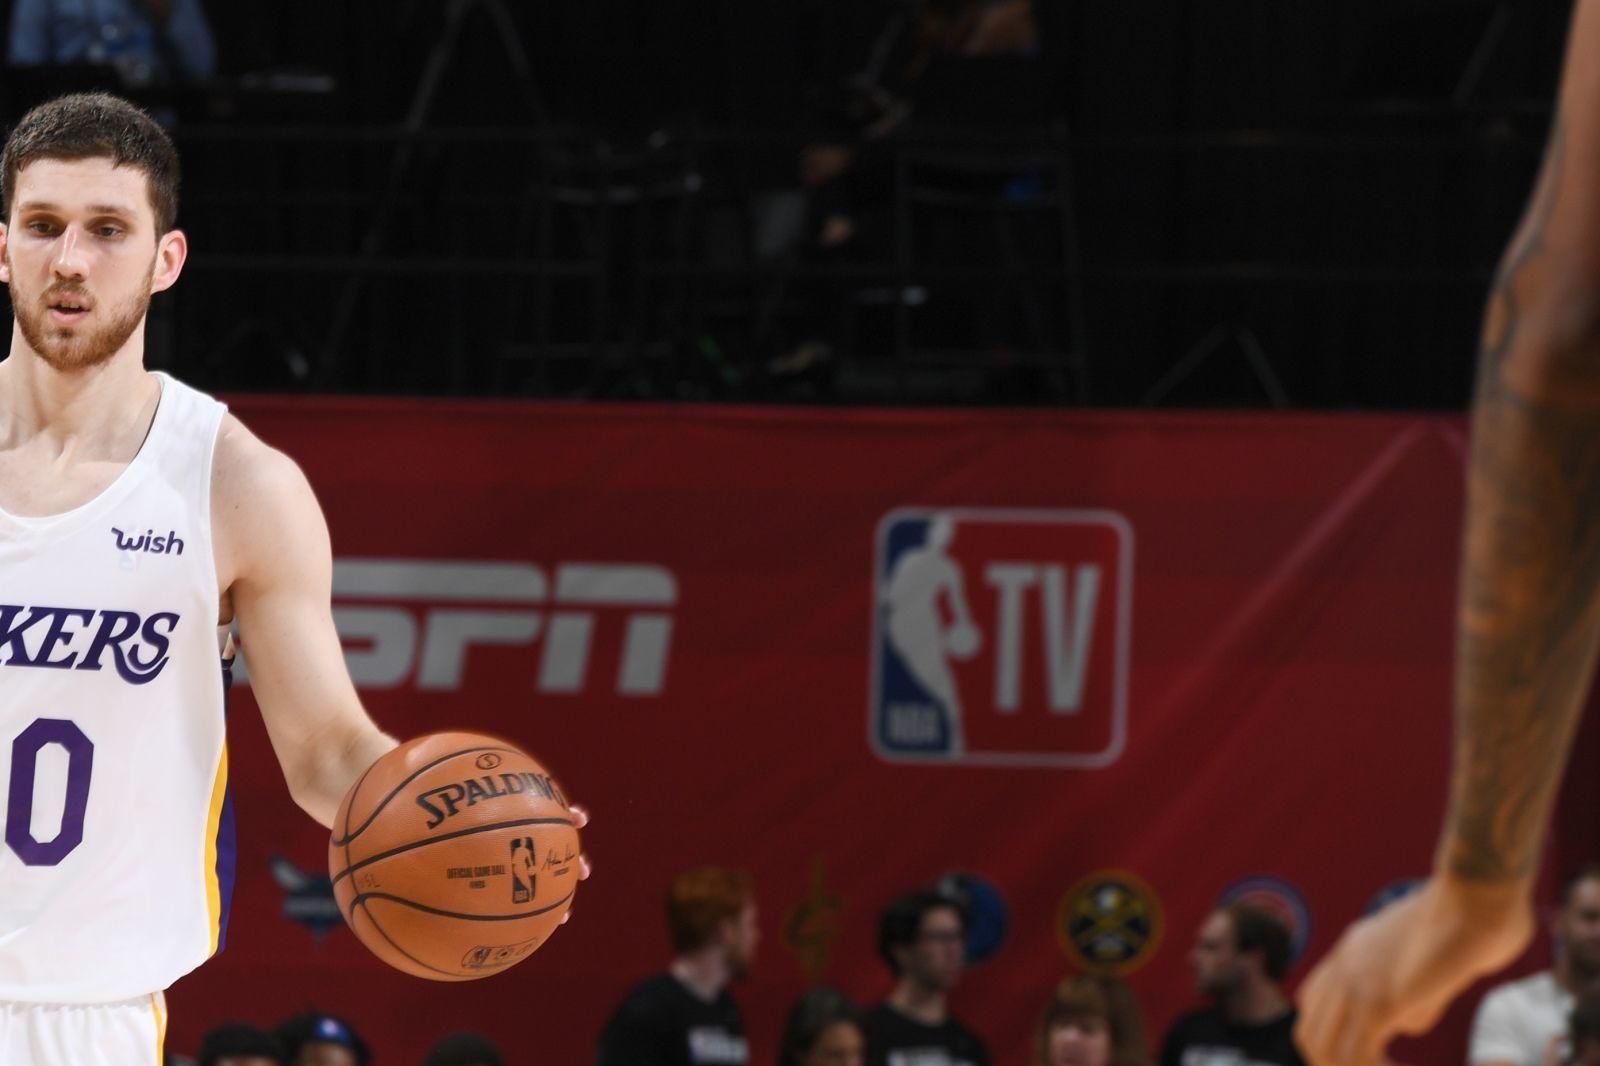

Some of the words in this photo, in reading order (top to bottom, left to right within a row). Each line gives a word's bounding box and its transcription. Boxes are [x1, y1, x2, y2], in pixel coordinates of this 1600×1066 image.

[110, 527, 184, 555] wish
[331, 558, 678, 696] SPN
[984, 561, 1101, 716] TV
[416, 772, 567, 829] SPALDING
